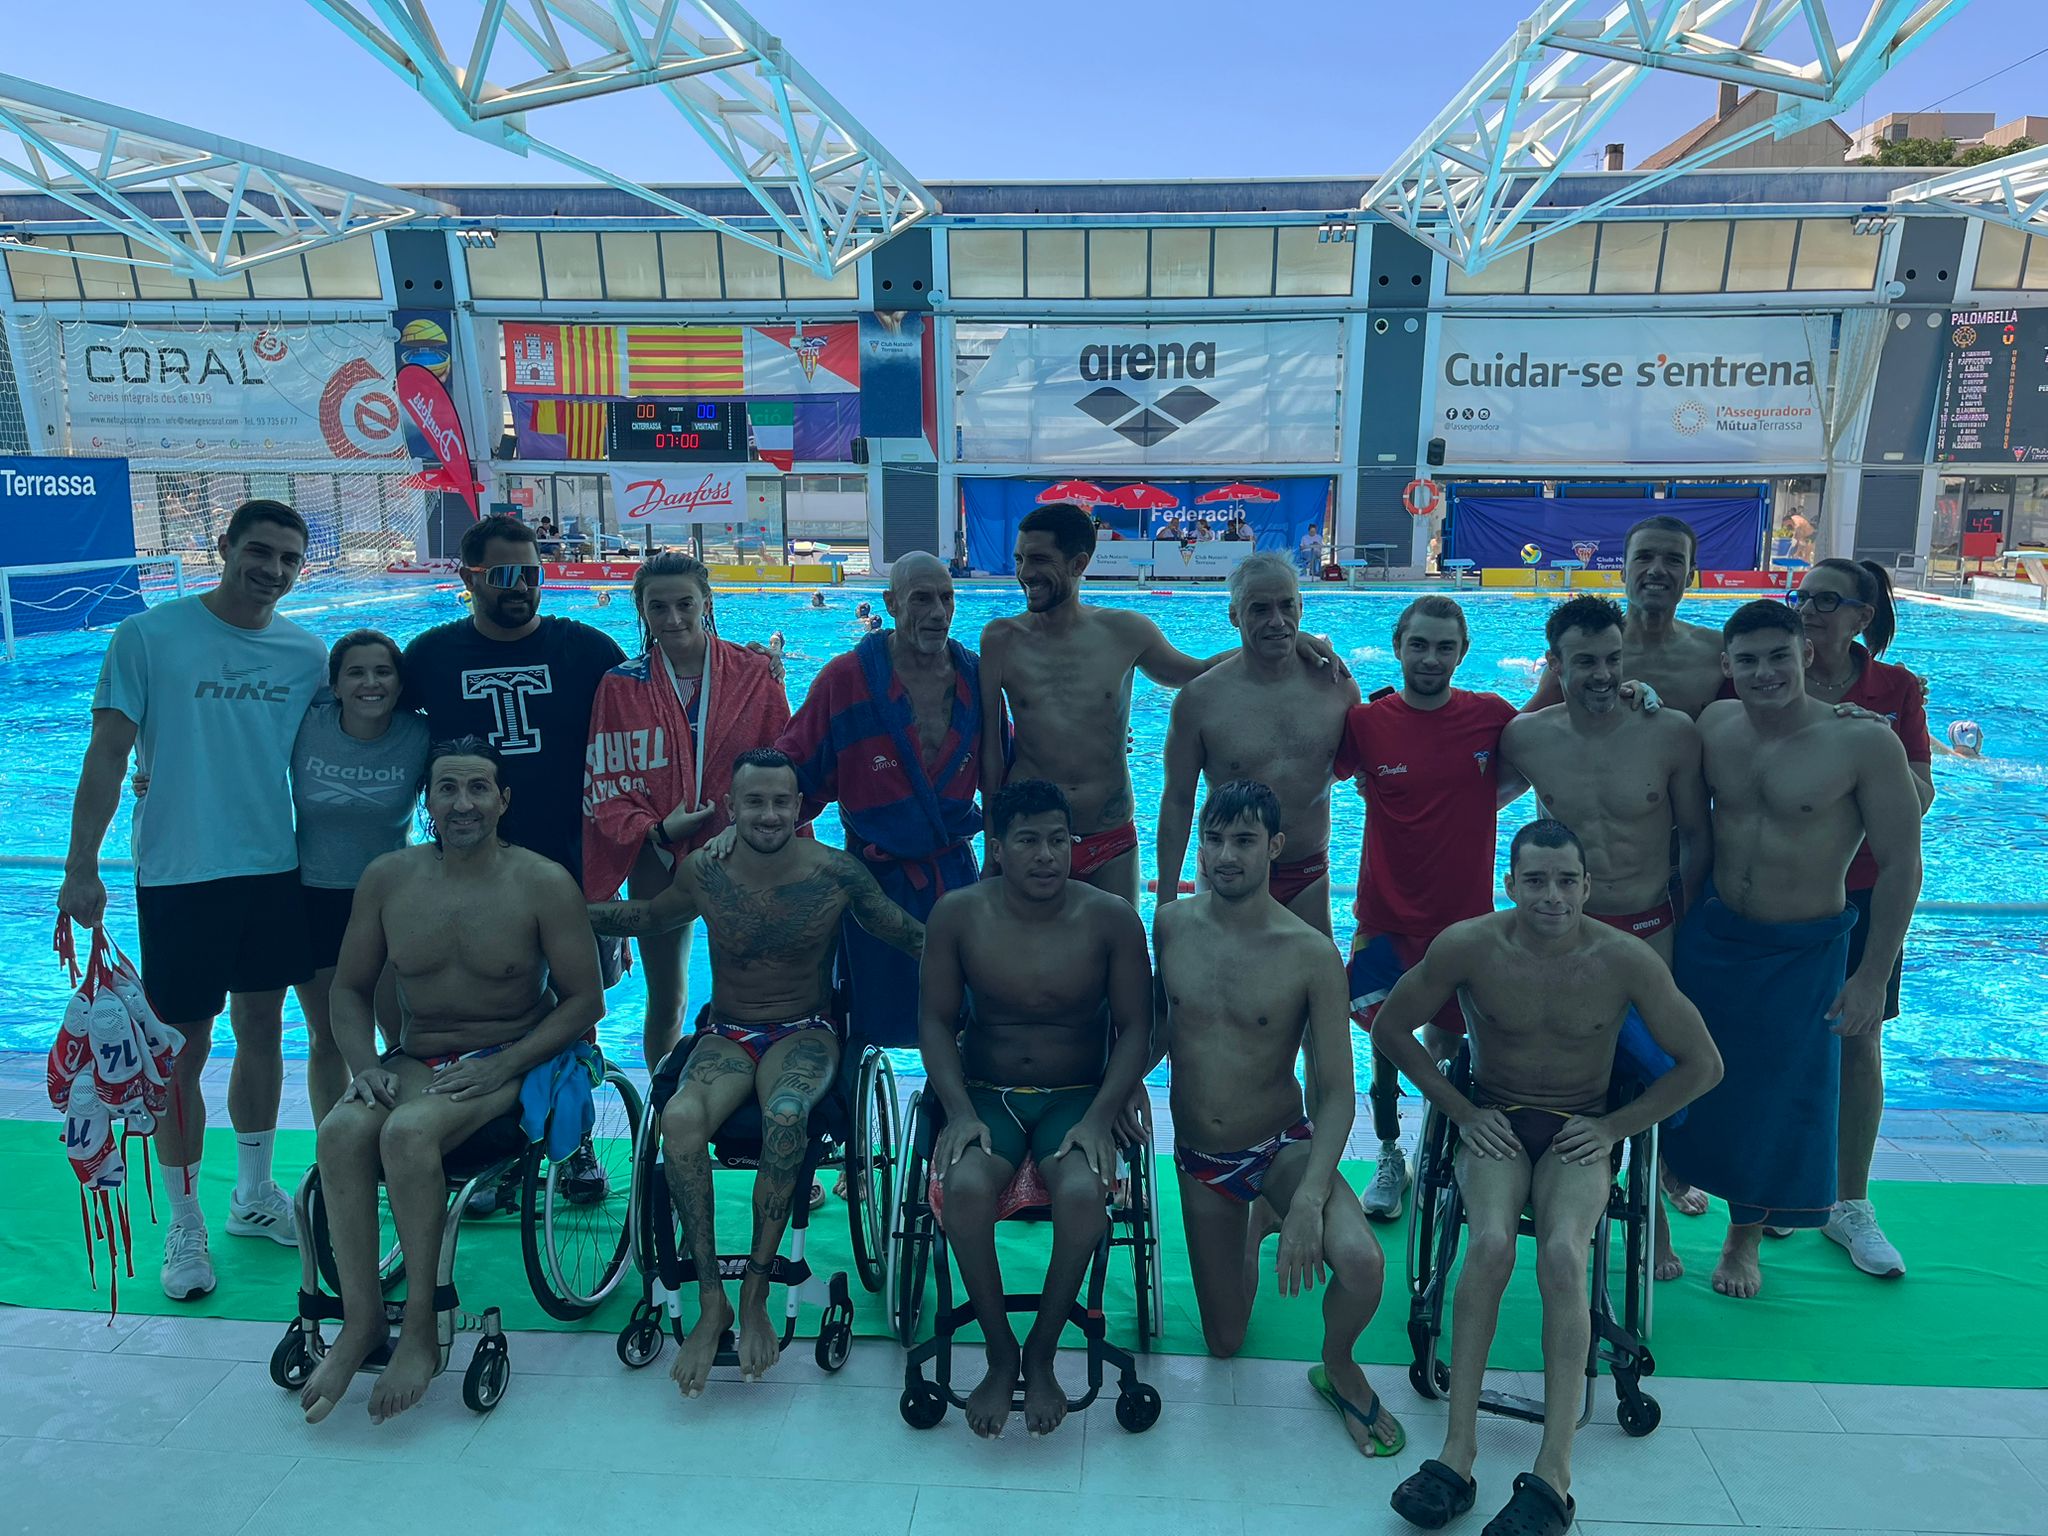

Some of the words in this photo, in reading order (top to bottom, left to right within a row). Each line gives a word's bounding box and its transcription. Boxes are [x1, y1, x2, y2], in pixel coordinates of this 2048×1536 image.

[1951, 310, 2018, 326] PALOMBELLA
[85, 345, 266, 385] CORAL
[1079, 340, 1217, 382] arena
[1444, 352, 1624, 388] Cuidar-se
[1636, 354, 1815, 388] s'entrena
[88, 391, 119, 402] Serveis
[121, 392, 159, 405] integrals
[161, 393, 177, 404] des
[190, 392, 212, 404] 1979
[637, 404, 655, 419] 00
[697, 404, 716, 419] 00
[1716, 406, 1812, 421] l'Asseguradora
[694, 422, 719, 430] VISITANT
[656, 433, 699, 448] 07:00
[0, 469, 97, 497] Terrassa
[624, 472, 734, 518] Danfoss
[1151, 503, 1246, 522] Federació
[1972, 517, 1993, 532] 45
[305, 756, 405, 782] Reebok
[1632, 917, 1661, 930] arena
[100, 1039, 138, 1073] 14
